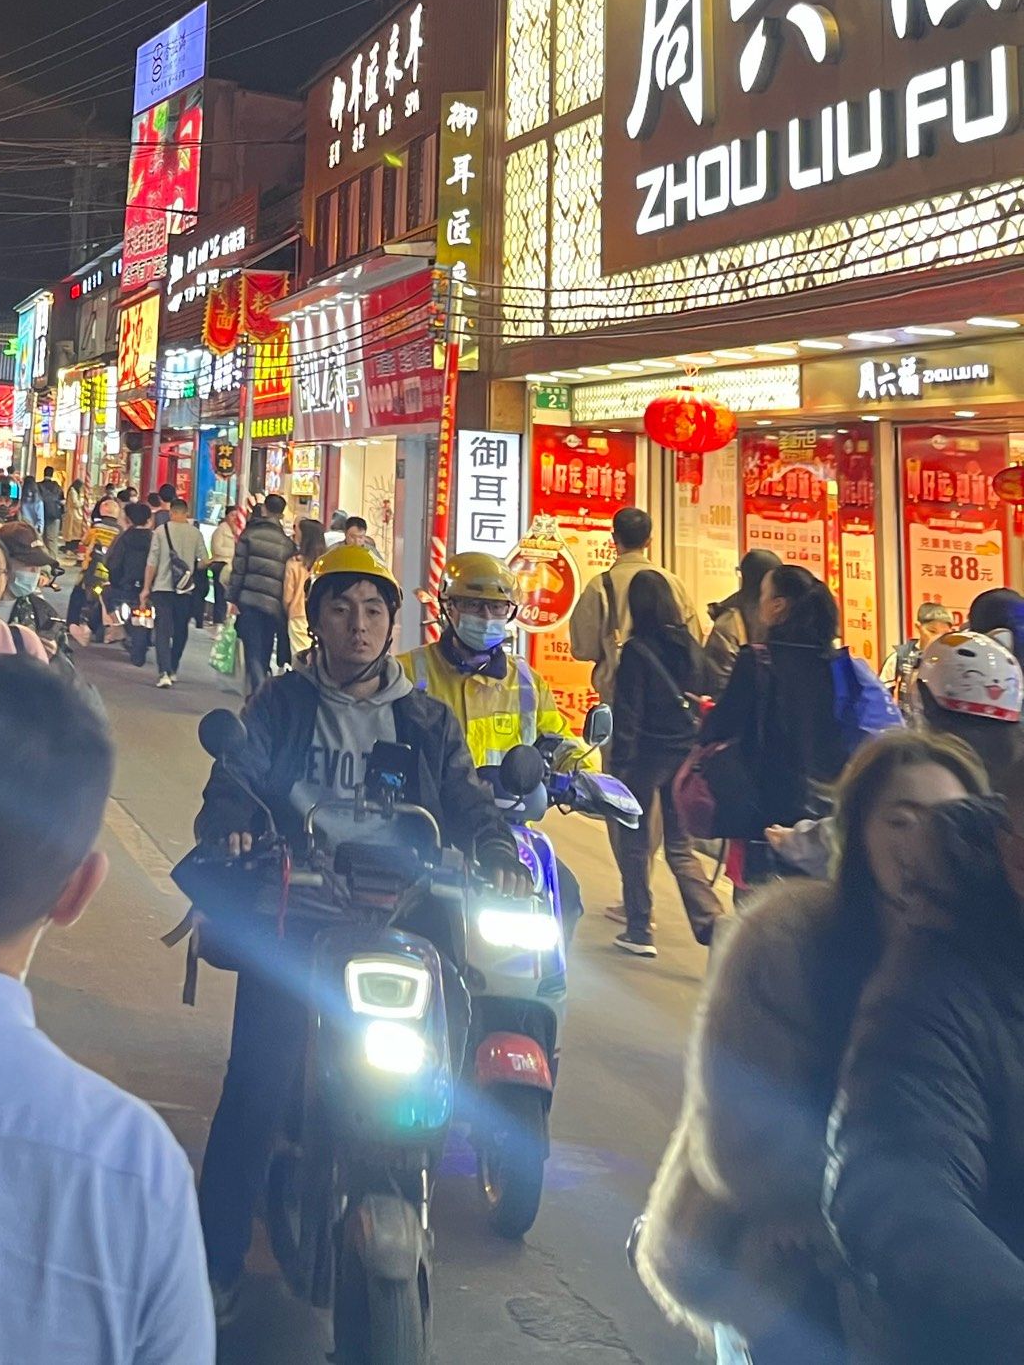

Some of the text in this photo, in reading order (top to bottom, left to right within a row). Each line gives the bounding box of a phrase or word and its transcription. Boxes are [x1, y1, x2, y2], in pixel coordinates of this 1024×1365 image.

[635, 45, 1006, 236] ZHOU LIU FU
[858, 356, 919, 399] 周六福
[470, 437, 507, 543] 御耳匠
